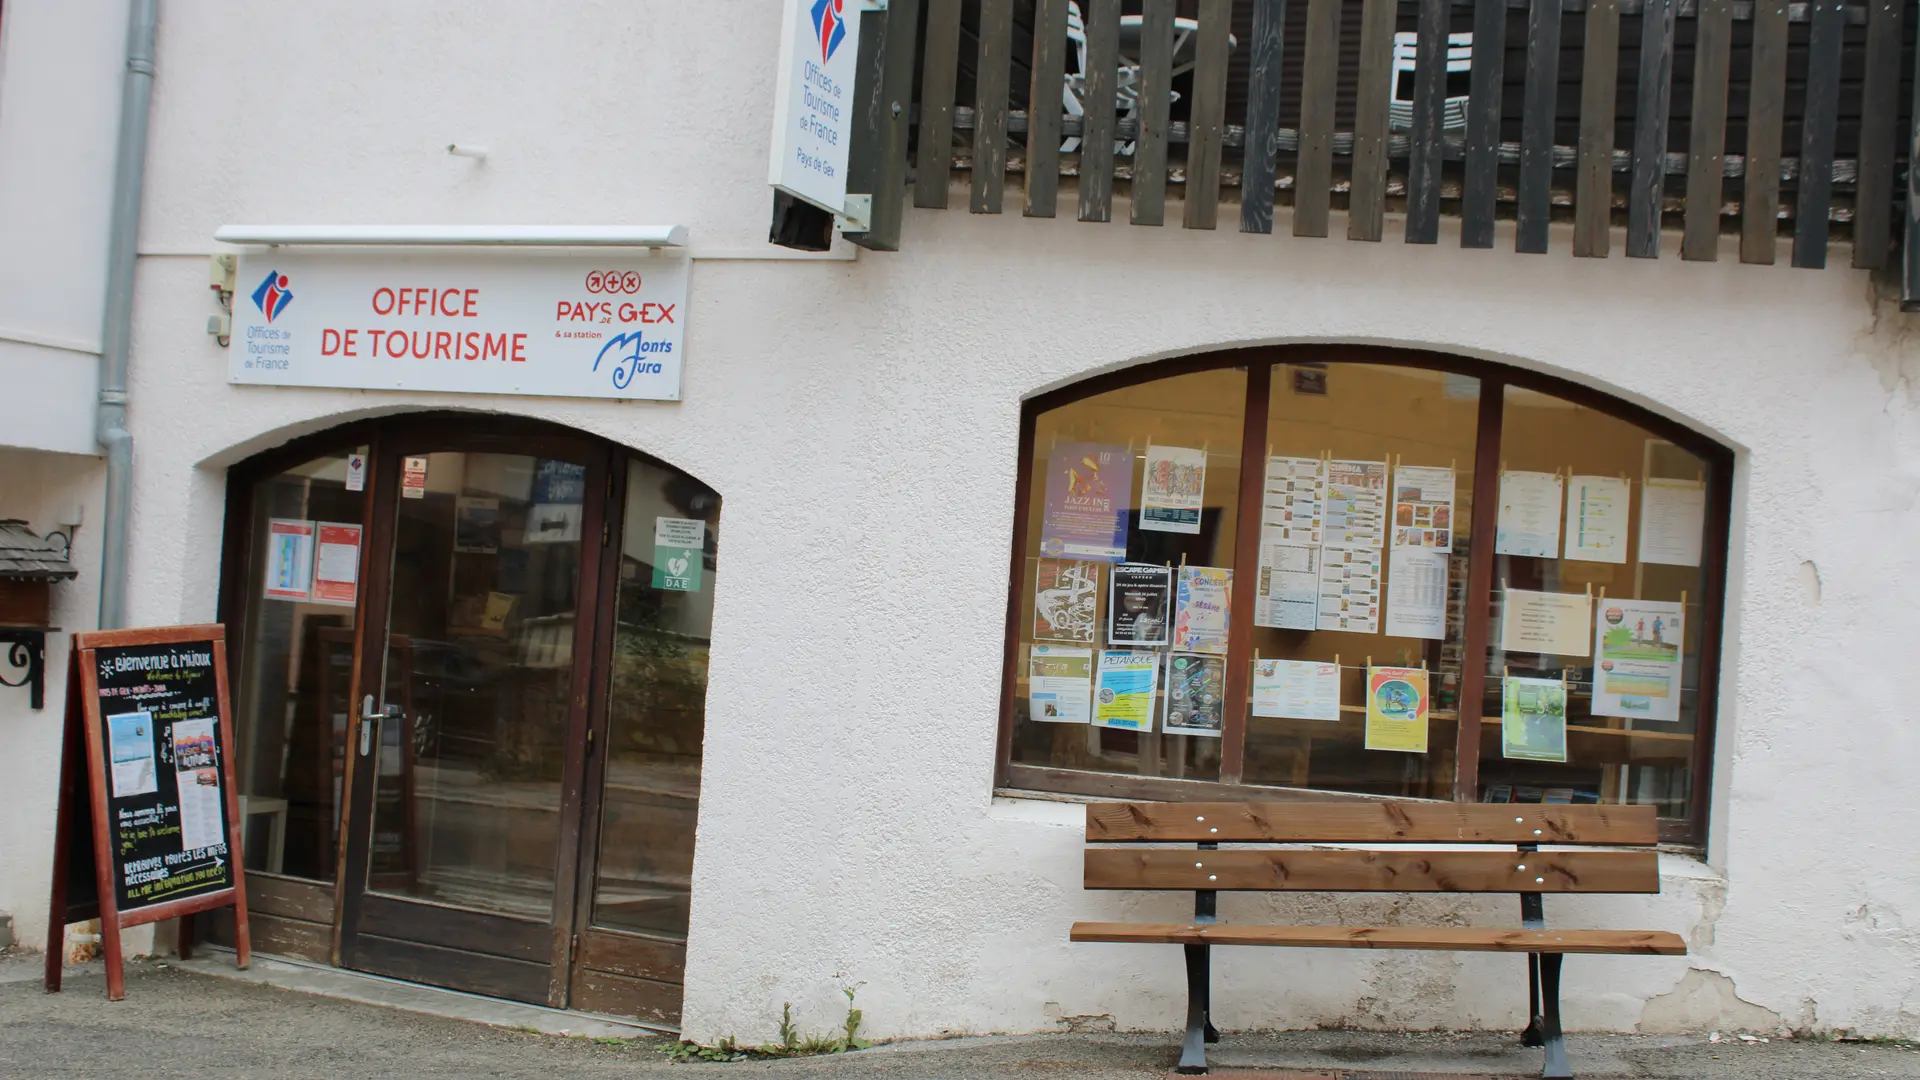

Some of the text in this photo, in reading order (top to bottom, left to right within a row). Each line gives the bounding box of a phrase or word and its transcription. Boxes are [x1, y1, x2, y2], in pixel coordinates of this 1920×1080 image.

[804, 60, 841, 99] Offices de
[803, 84, 840, 122] Tourisme
[800, 114, 838, 146] de France
[797, 147, 835, 177] Pays de Gex
[372, 287, 479, 317] OFFICE
[557, 301, 612, 321] PAYS
[618, 302, 675, 323] GEX
[247, 326, 280, 340] Offices
[555, 330, 561, 338] &
[574, 330, 602, 339] station
[247, 340, 290, 355] Tourisme
[321, 329, 528, 362] DE TOURISME
[592, 330, 672, 372] Monts
[256, 356, 289, 370] France
[1064, 496, 1103, 506] JAZZ IN
[665, 578, 688, 589] DAE
[1195, 577, 1227, 586] CONCERT
